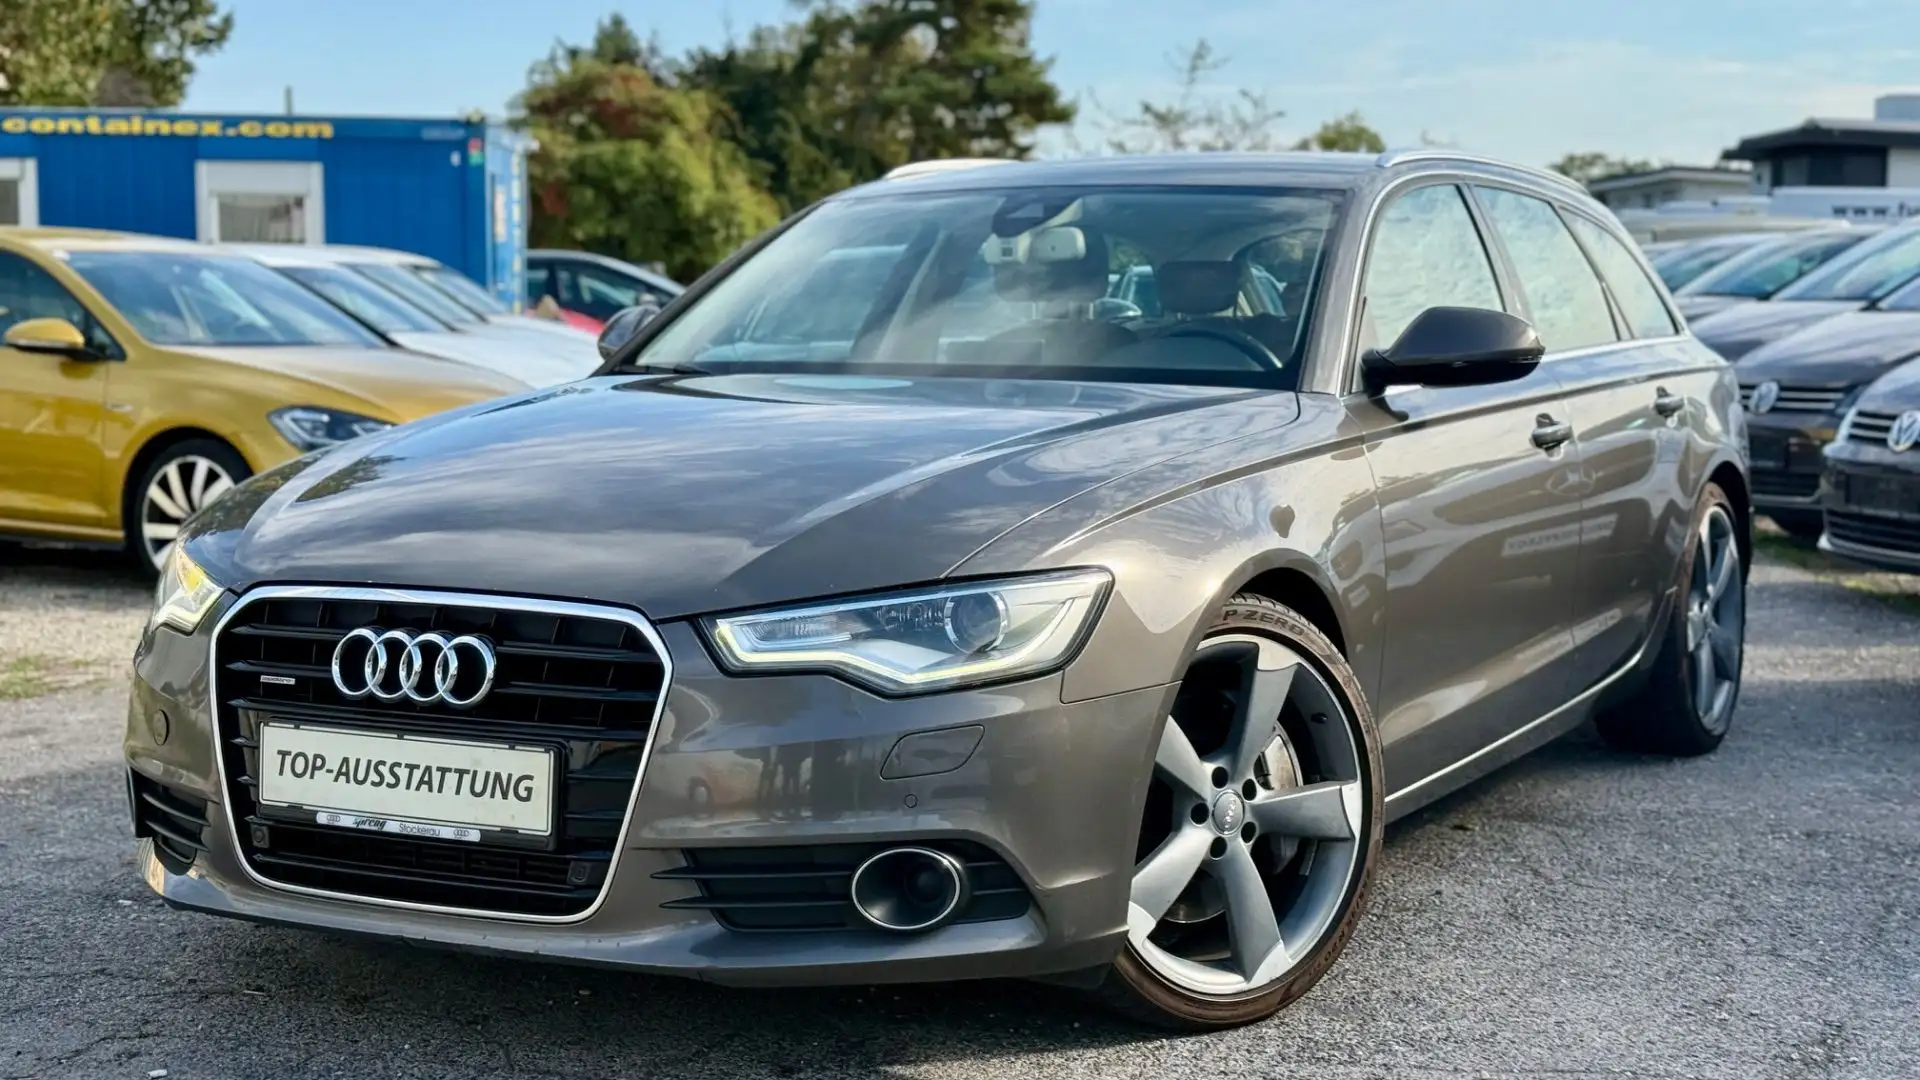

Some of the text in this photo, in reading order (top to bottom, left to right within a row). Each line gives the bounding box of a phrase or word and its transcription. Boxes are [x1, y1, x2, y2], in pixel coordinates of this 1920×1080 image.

[2, 116, 333, 138] containex.com
[1223, 609, 1304, 636] P ZERO
[277, 750, 534, 802] TOP-AUSSTATTUNG
[399, 823, 441, 837] Stockerau
